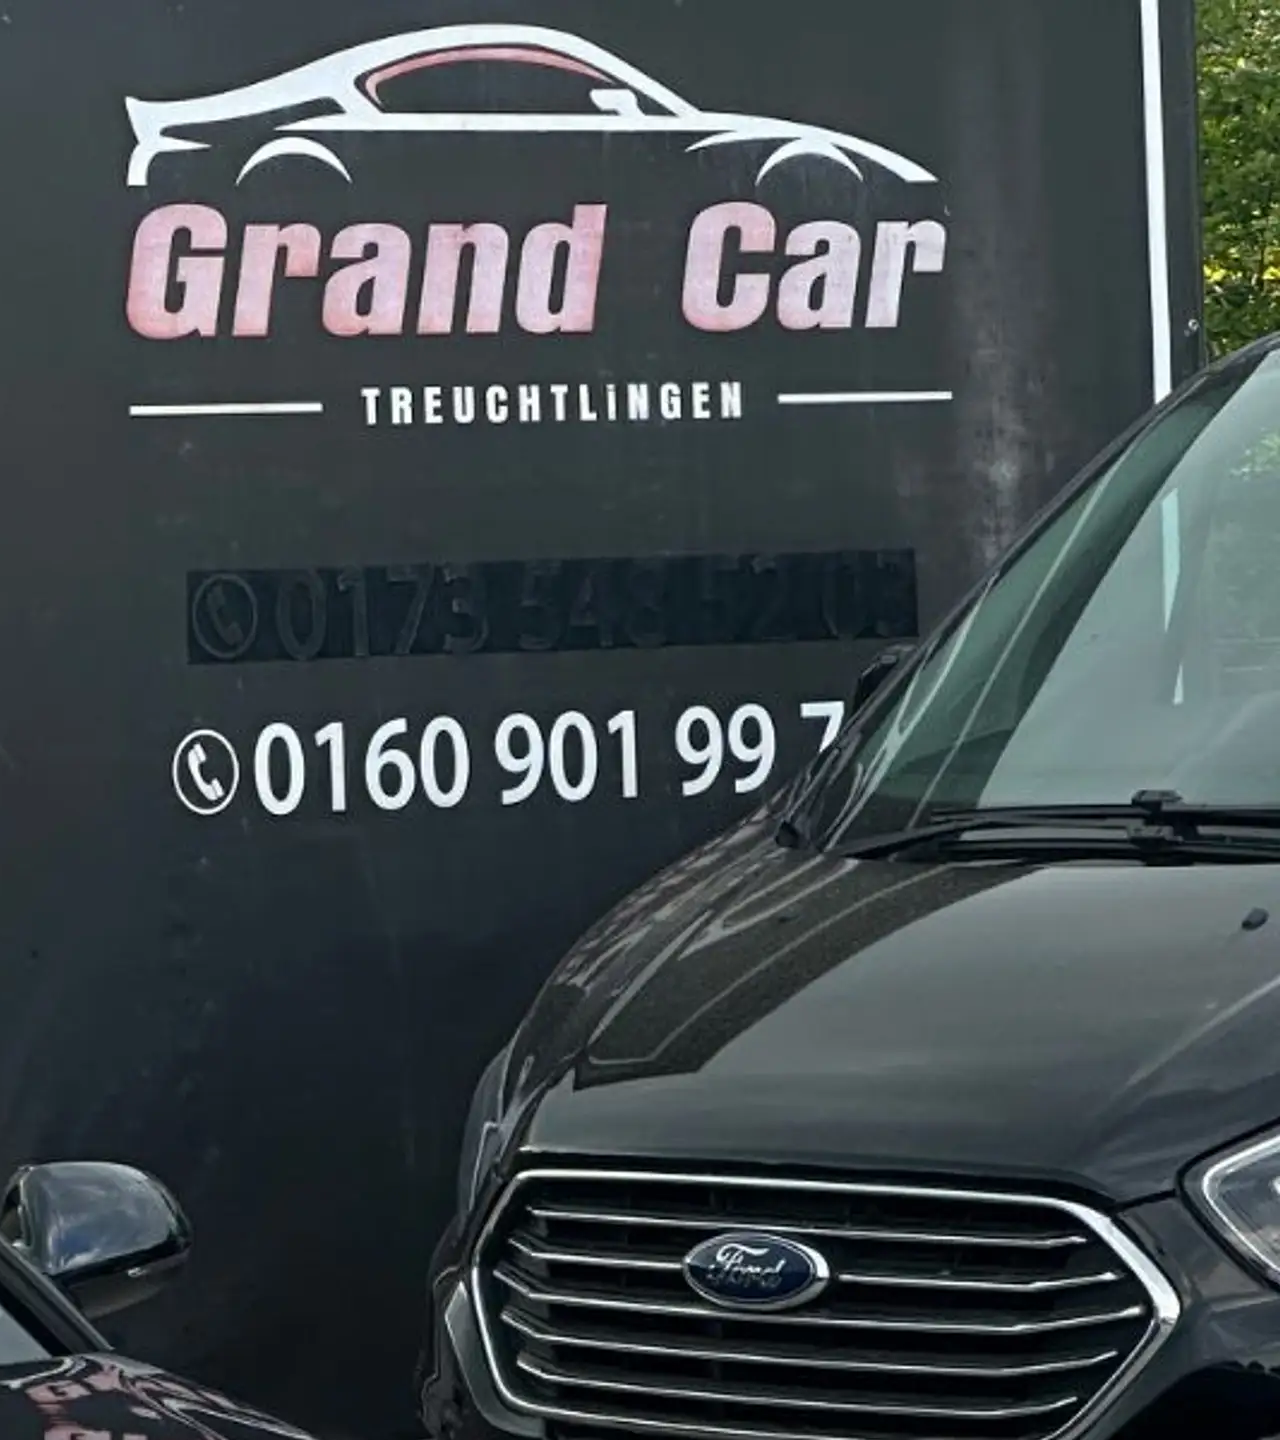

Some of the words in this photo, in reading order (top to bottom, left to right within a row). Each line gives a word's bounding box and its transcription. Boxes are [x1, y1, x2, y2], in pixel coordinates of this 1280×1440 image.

[126, 203, 607, 338] Grand
[681, 201, 946, 331] Car
[254, 715, 470, 815] 0160
[494, 710, 638, 805] 901
[675, 703, 777, 796] 99
[707, 1242, 787, 1288] Ford
